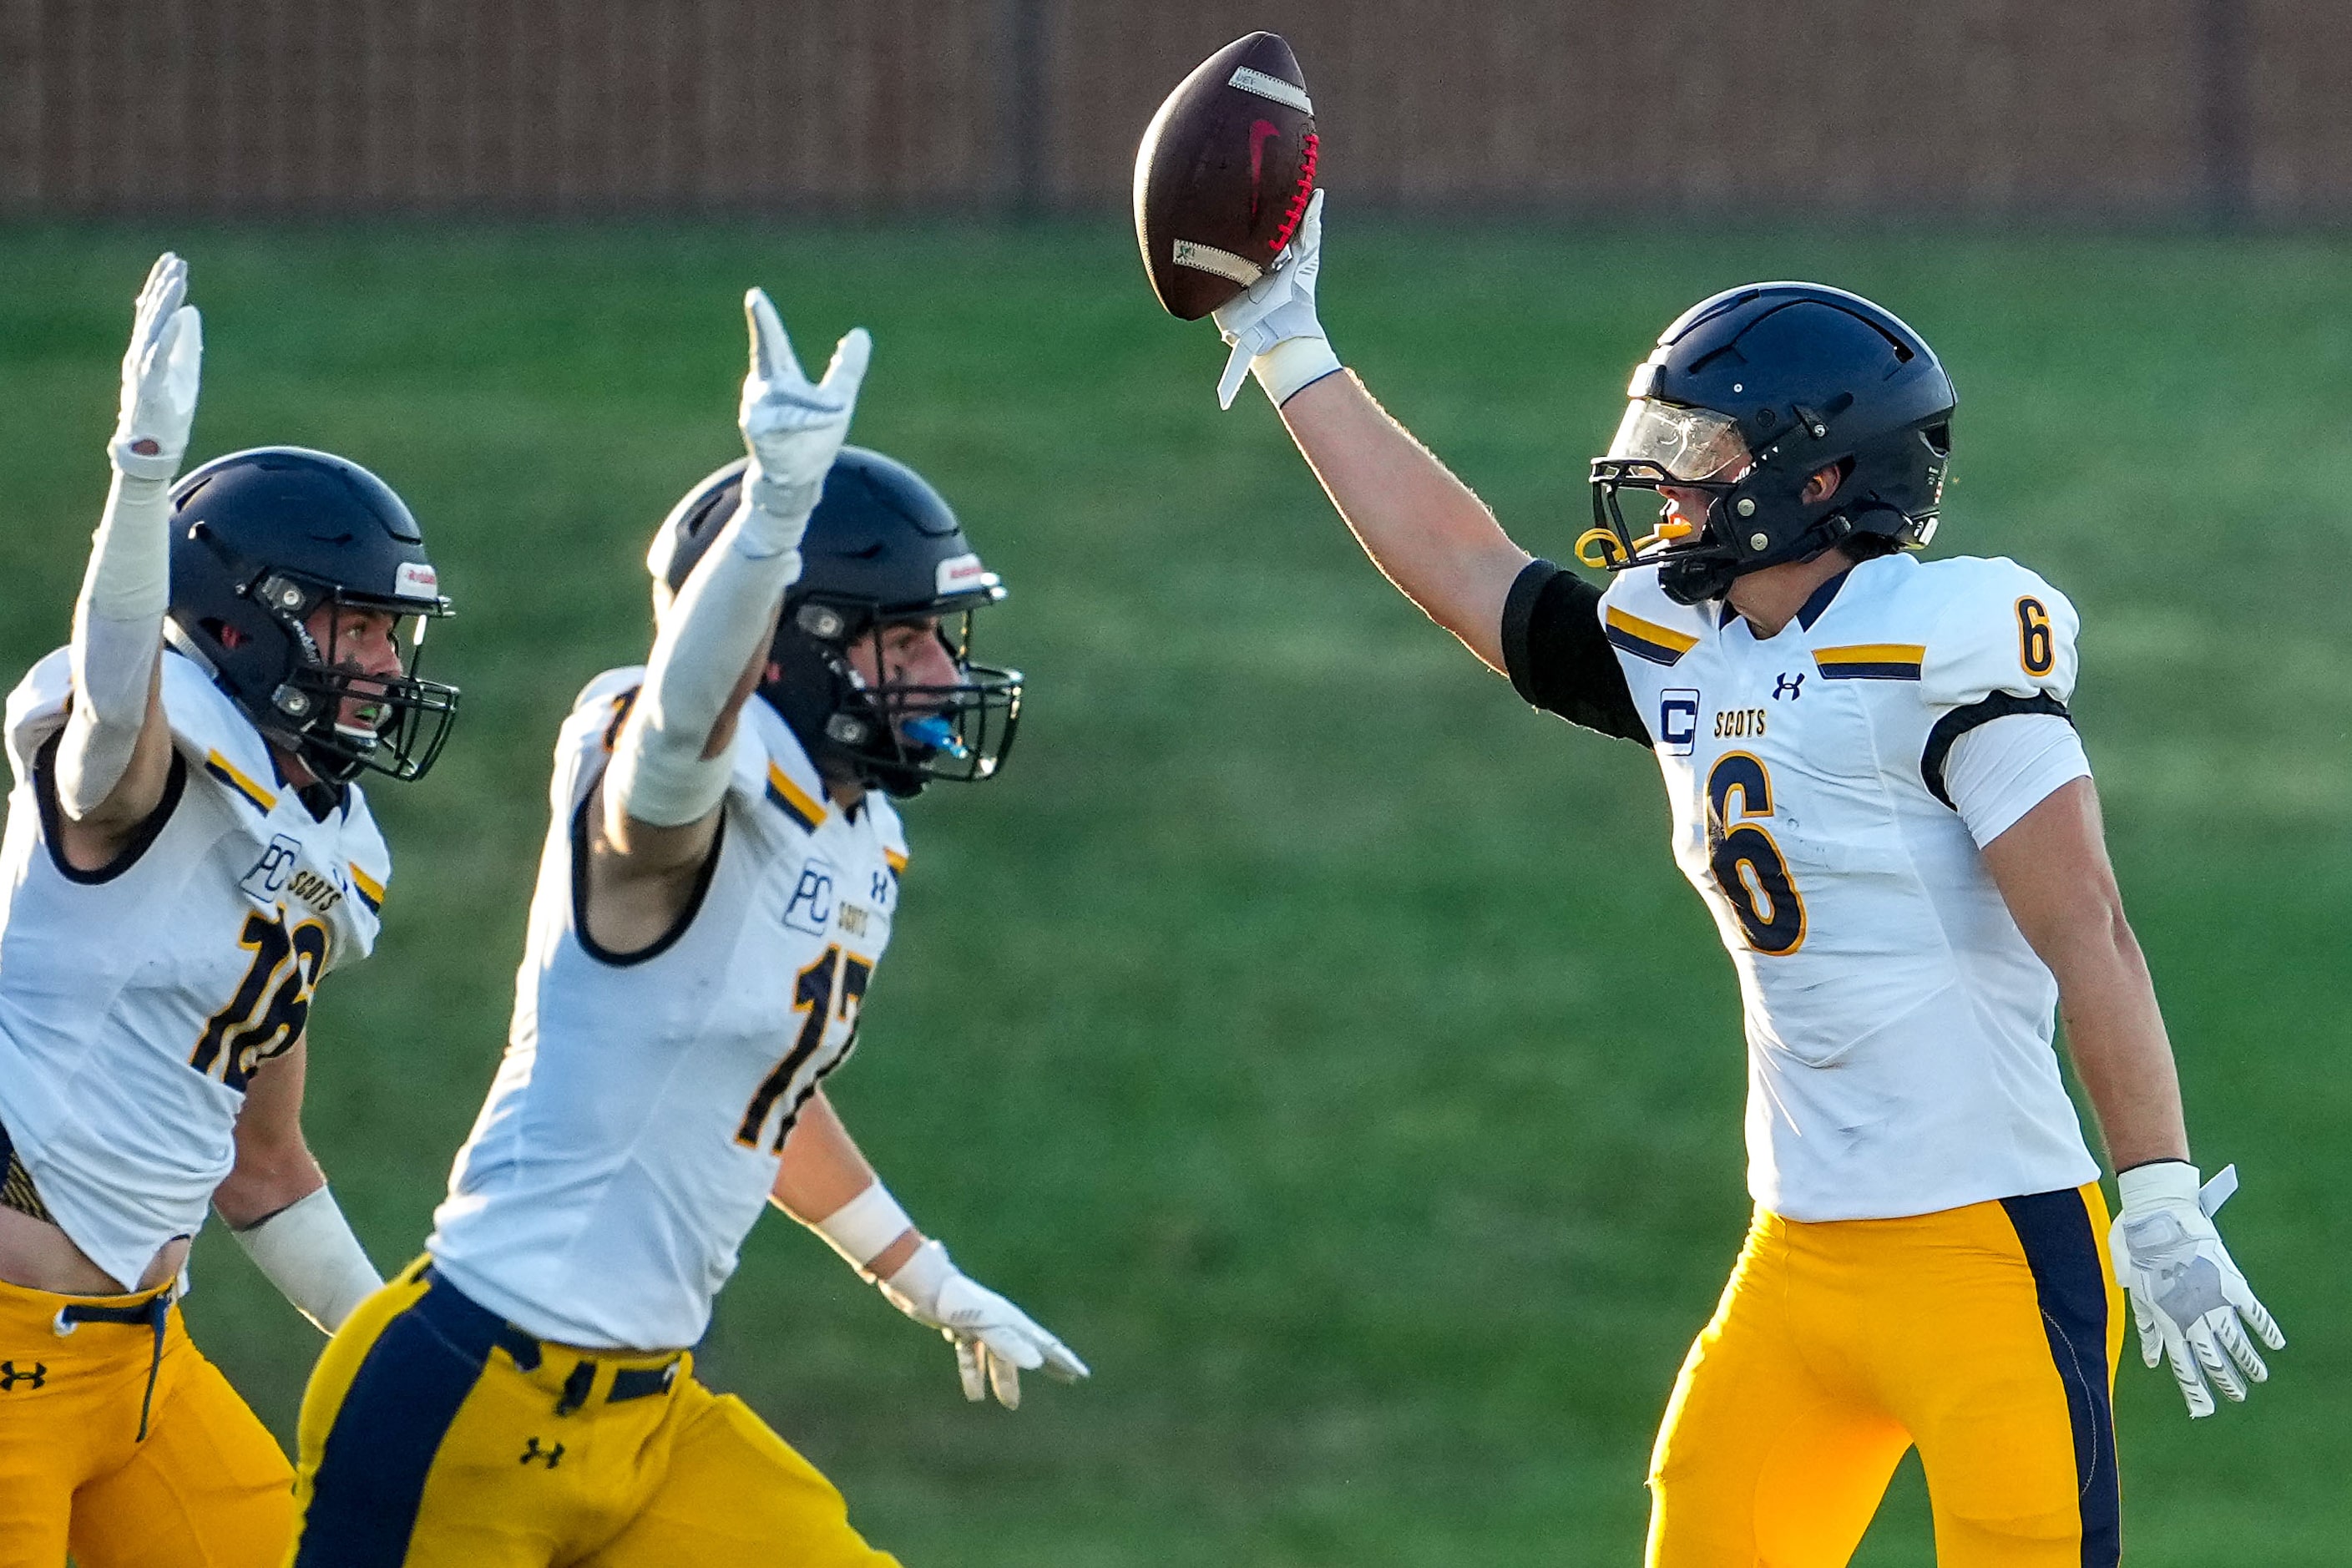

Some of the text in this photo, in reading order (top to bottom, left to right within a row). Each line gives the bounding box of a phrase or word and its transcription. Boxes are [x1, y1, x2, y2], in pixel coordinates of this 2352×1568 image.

[2015, 594, 2056, 677] 6
[1661, 700, 1697, 744] C
[1714, 709, 1768, 738] SCOTS
[245, 843, 296, 892] PC
[1704, 750, 1808, 957] 6
[287, 870, 342, 912] SCOTS
[787, 869, 833, 923] PC
[732, 942, 874, 1156] 17
